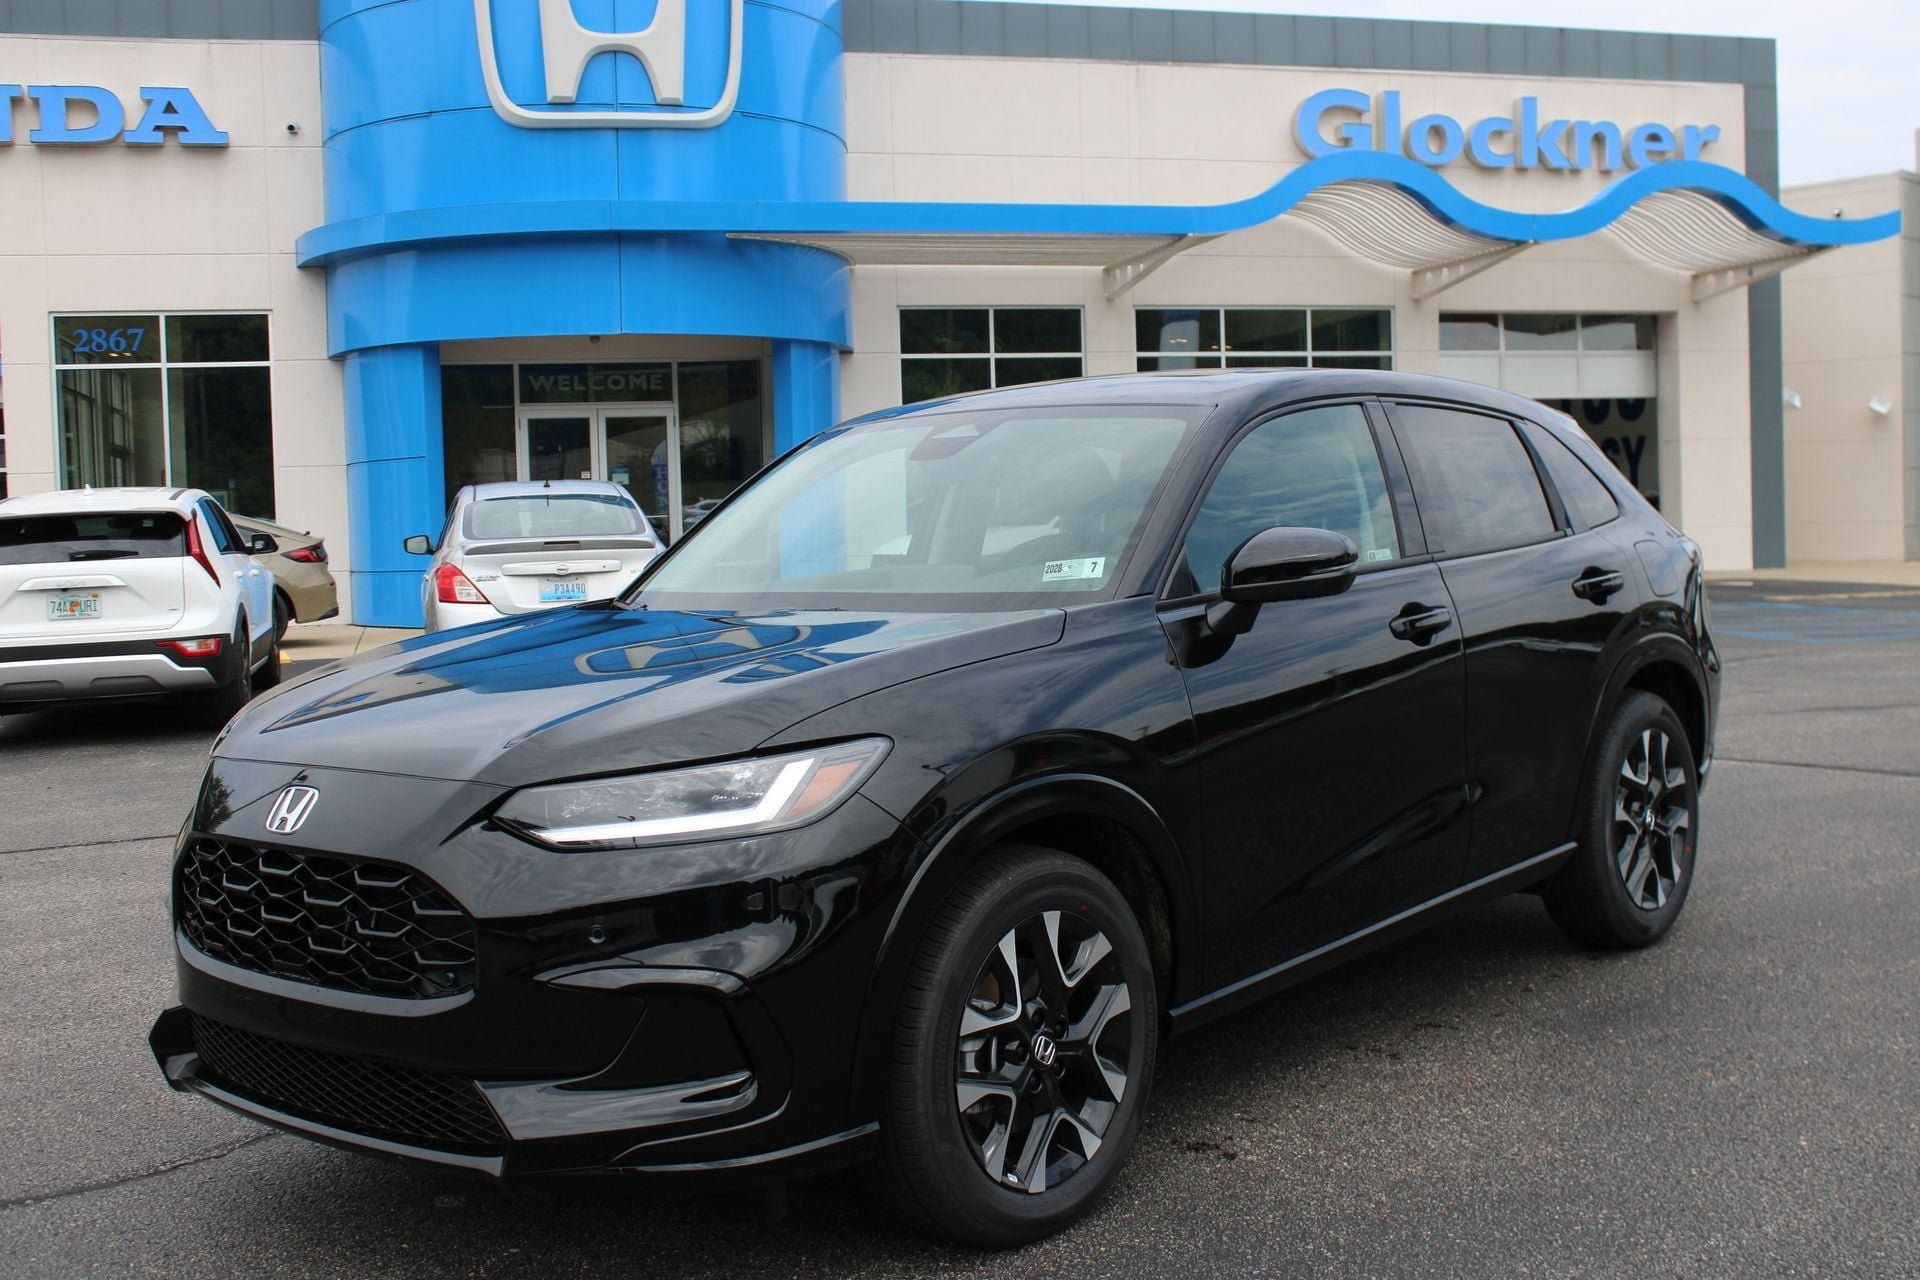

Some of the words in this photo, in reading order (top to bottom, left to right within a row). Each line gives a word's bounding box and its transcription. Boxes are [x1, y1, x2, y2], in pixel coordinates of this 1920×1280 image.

[0, 84, 230, 148] DA
[1292, 88, 1721, 171] Glockner
[72, 327, 145, 352] 2867
[529, 374, 663, 391] WELCOME
[1091, 561, 1098, 573] 7
